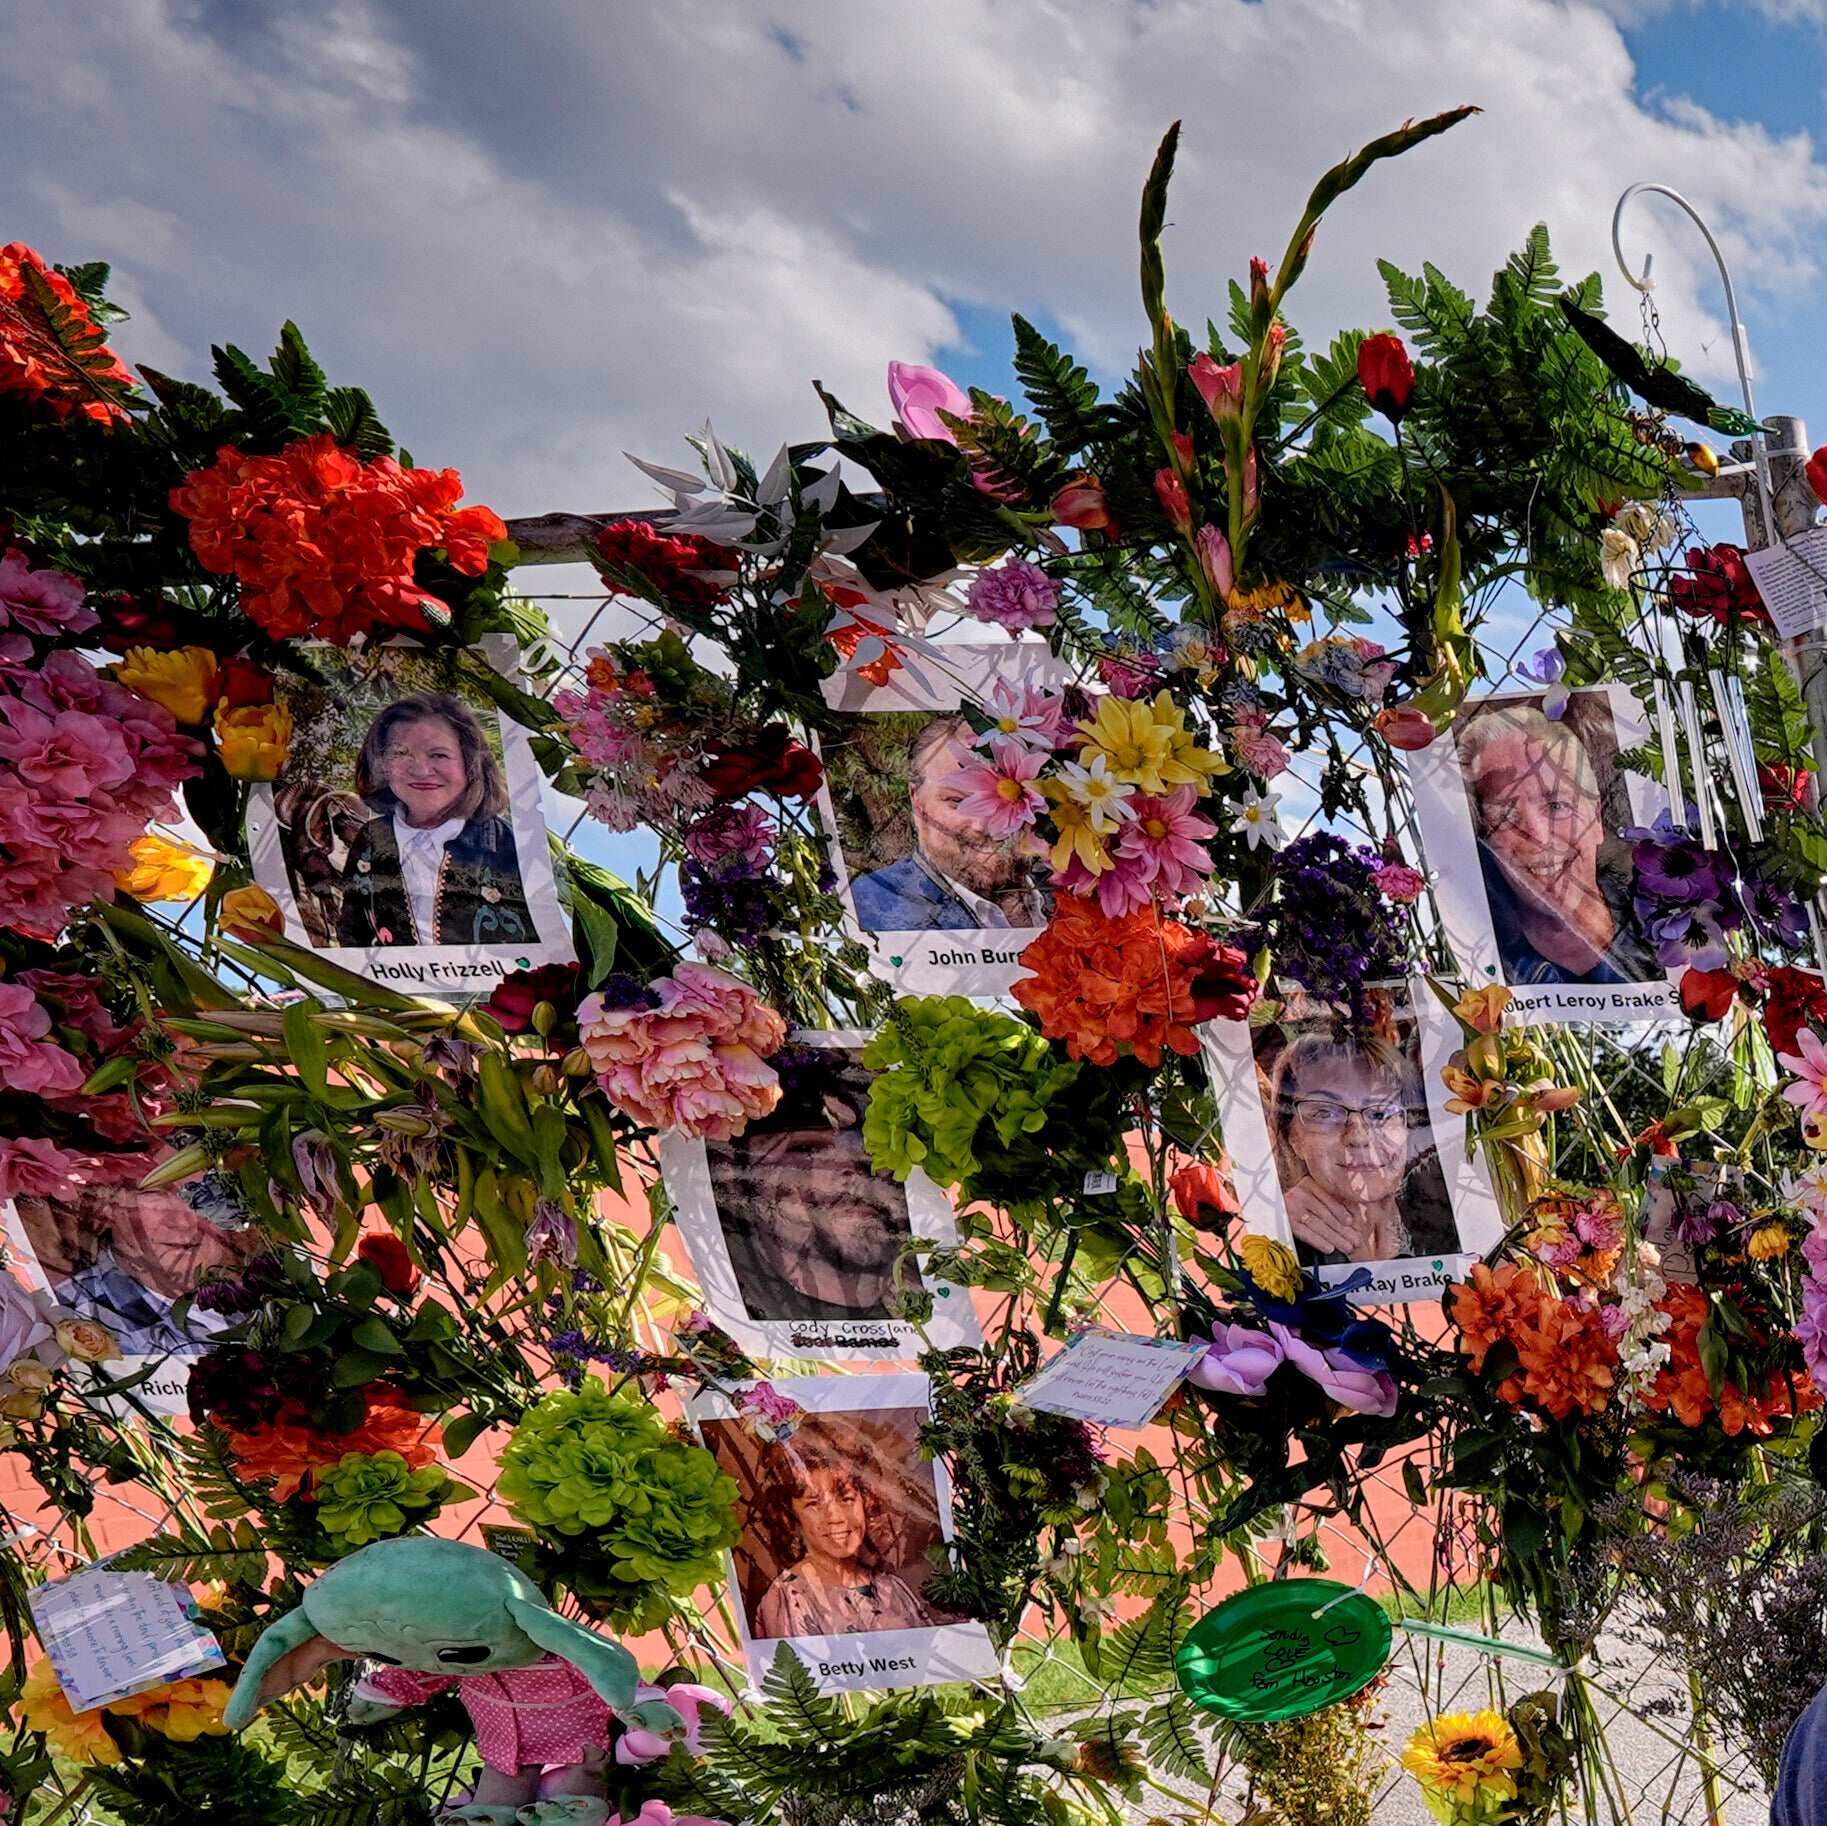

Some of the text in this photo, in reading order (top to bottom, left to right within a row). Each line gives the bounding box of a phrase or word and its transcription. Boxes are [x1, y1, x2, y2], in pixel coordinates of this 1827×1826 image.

[928, 949, 977, 965] John
[370, 960, 507, 982] Holly Frizzell
[1556, 993, 1605, 1010] Leroy
[1612, 993, 1664, 1008] Brake
[1401, 1272, 1453, 1288] Brake
[789, 1319, 829, 1337] Cody
[141, 1380, 188, 1395] Rich
[819, 1656, 917, 1676] Betty West
